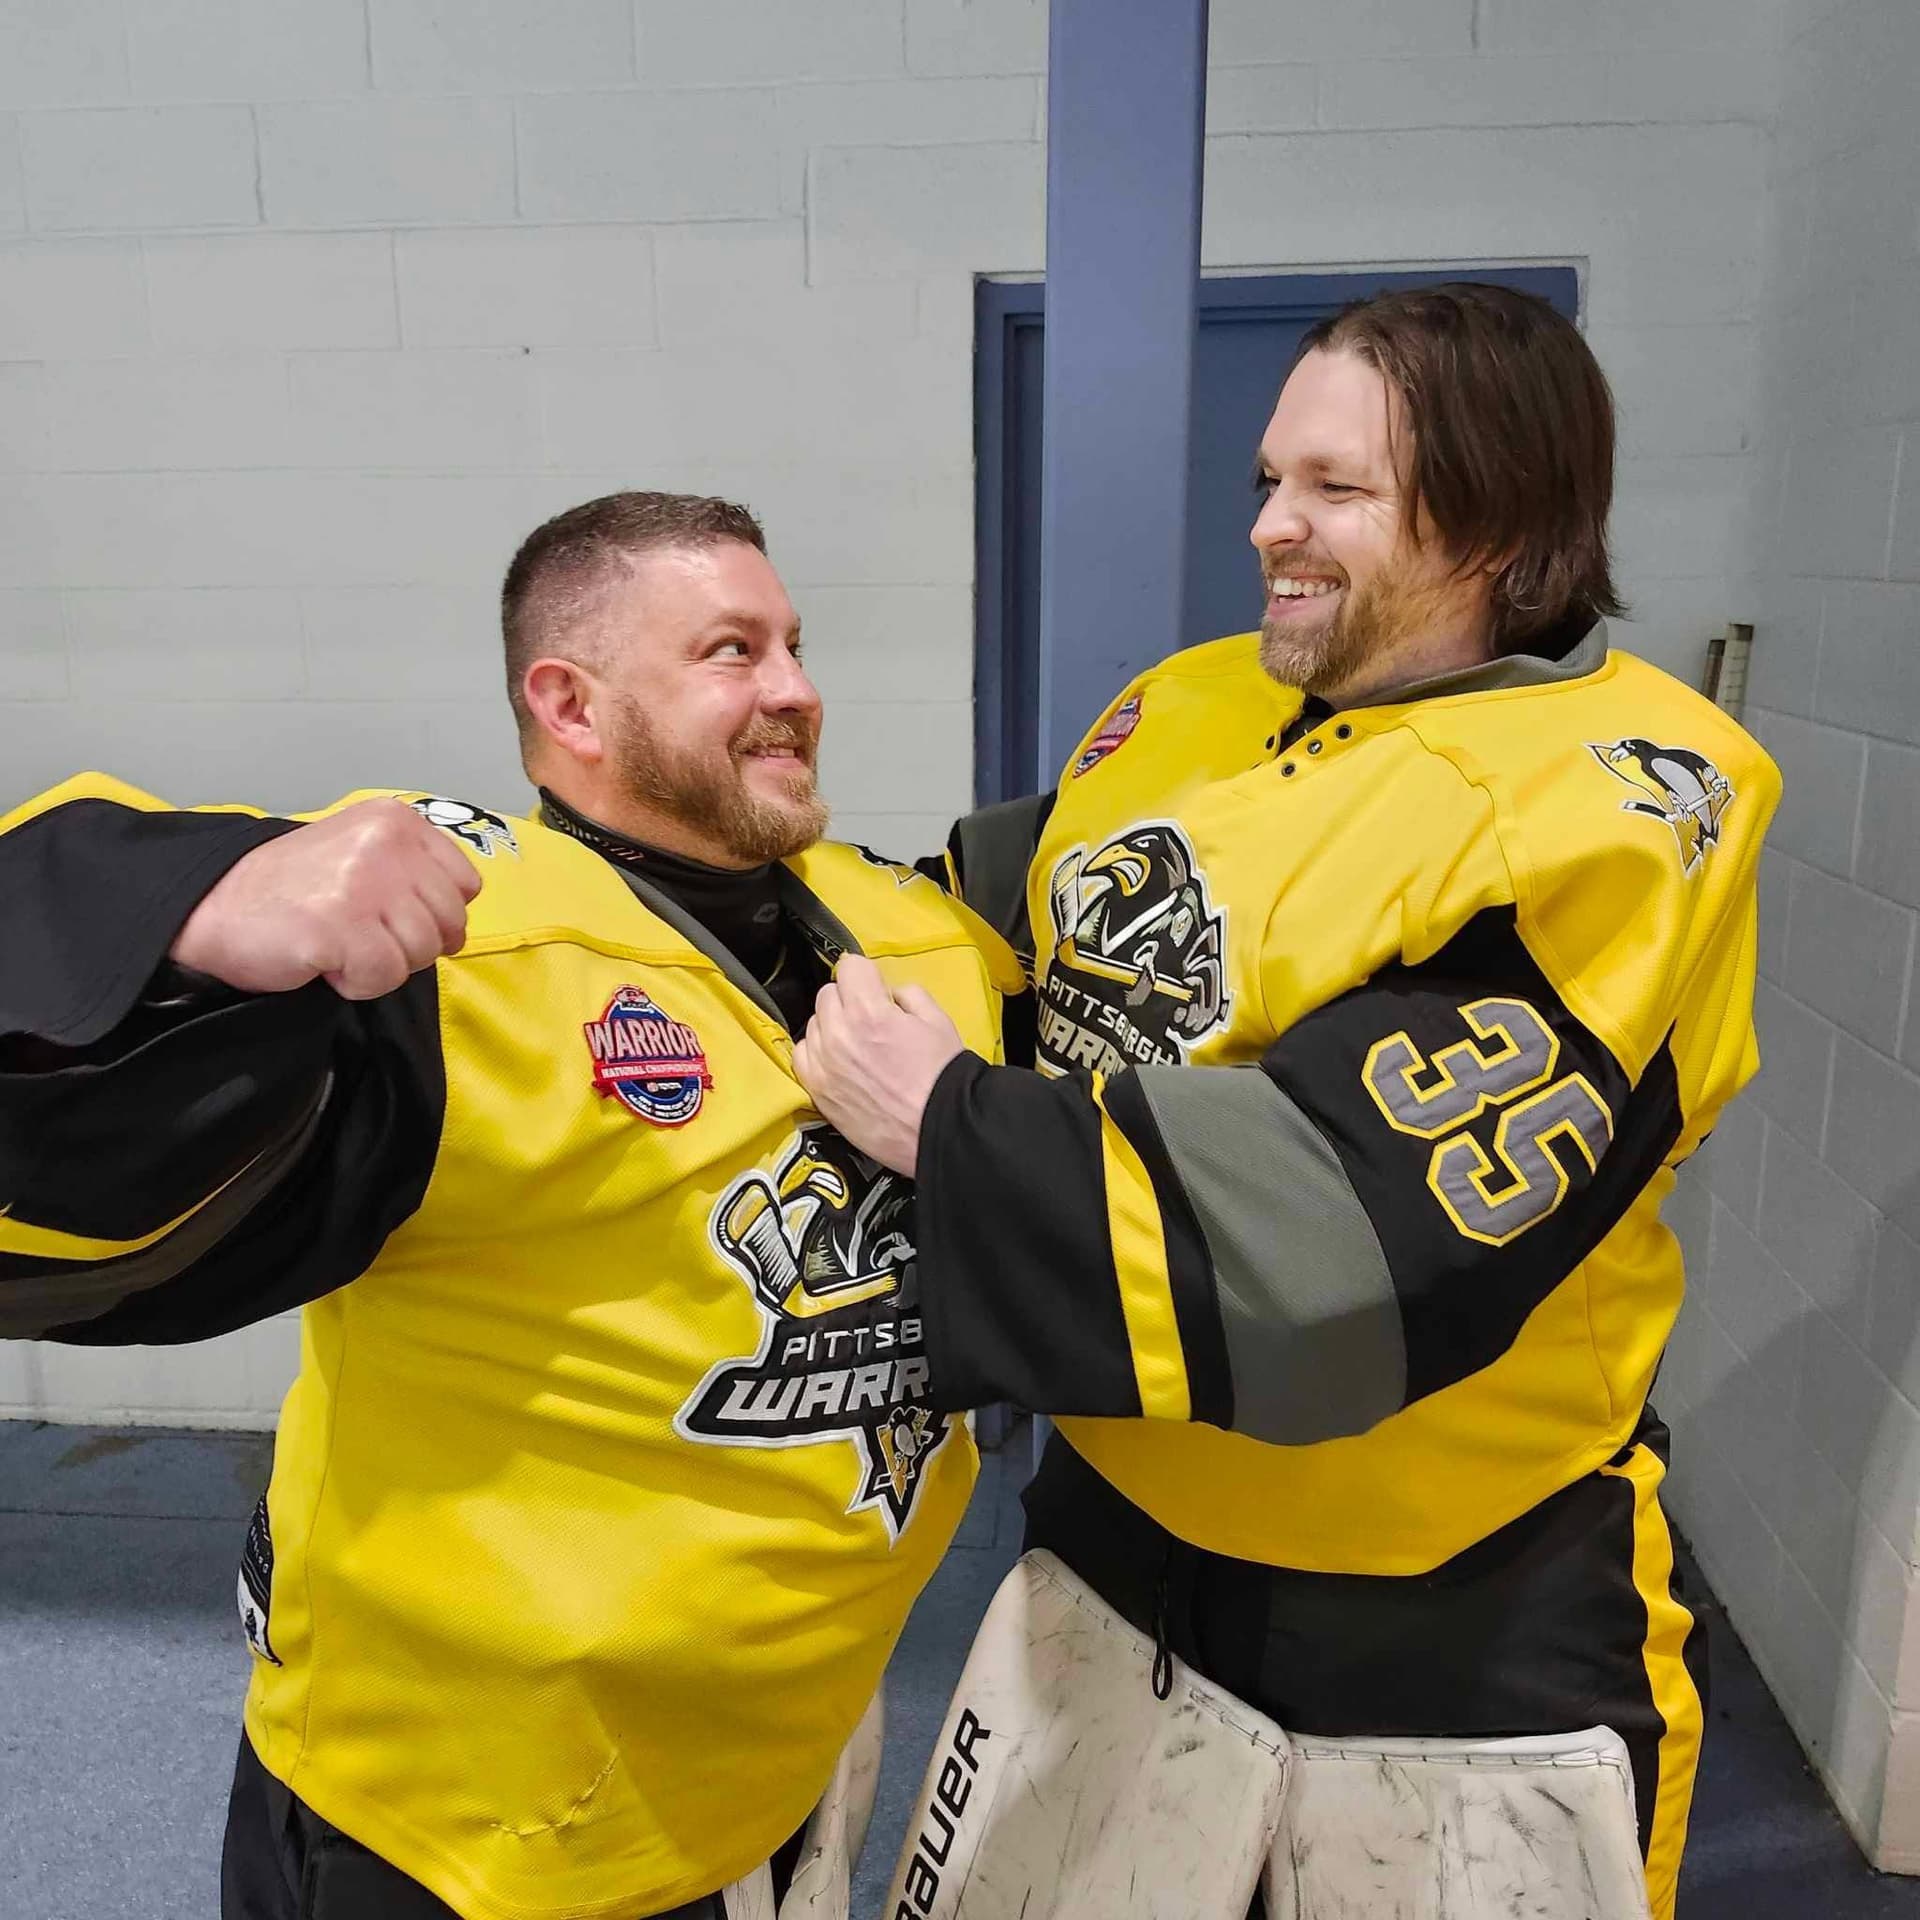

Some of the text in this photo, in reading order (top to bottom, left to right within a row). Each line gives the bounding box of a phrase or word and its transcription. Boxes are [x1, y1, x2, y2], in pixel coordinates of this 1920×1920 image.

[585, 1019, 701, 1062] WARRIOR
[1361, 997, 1614, 1247] 35
[781, 1318, 923, 1366] PITTSB
[716, 1355, 930, 1421] WARR
